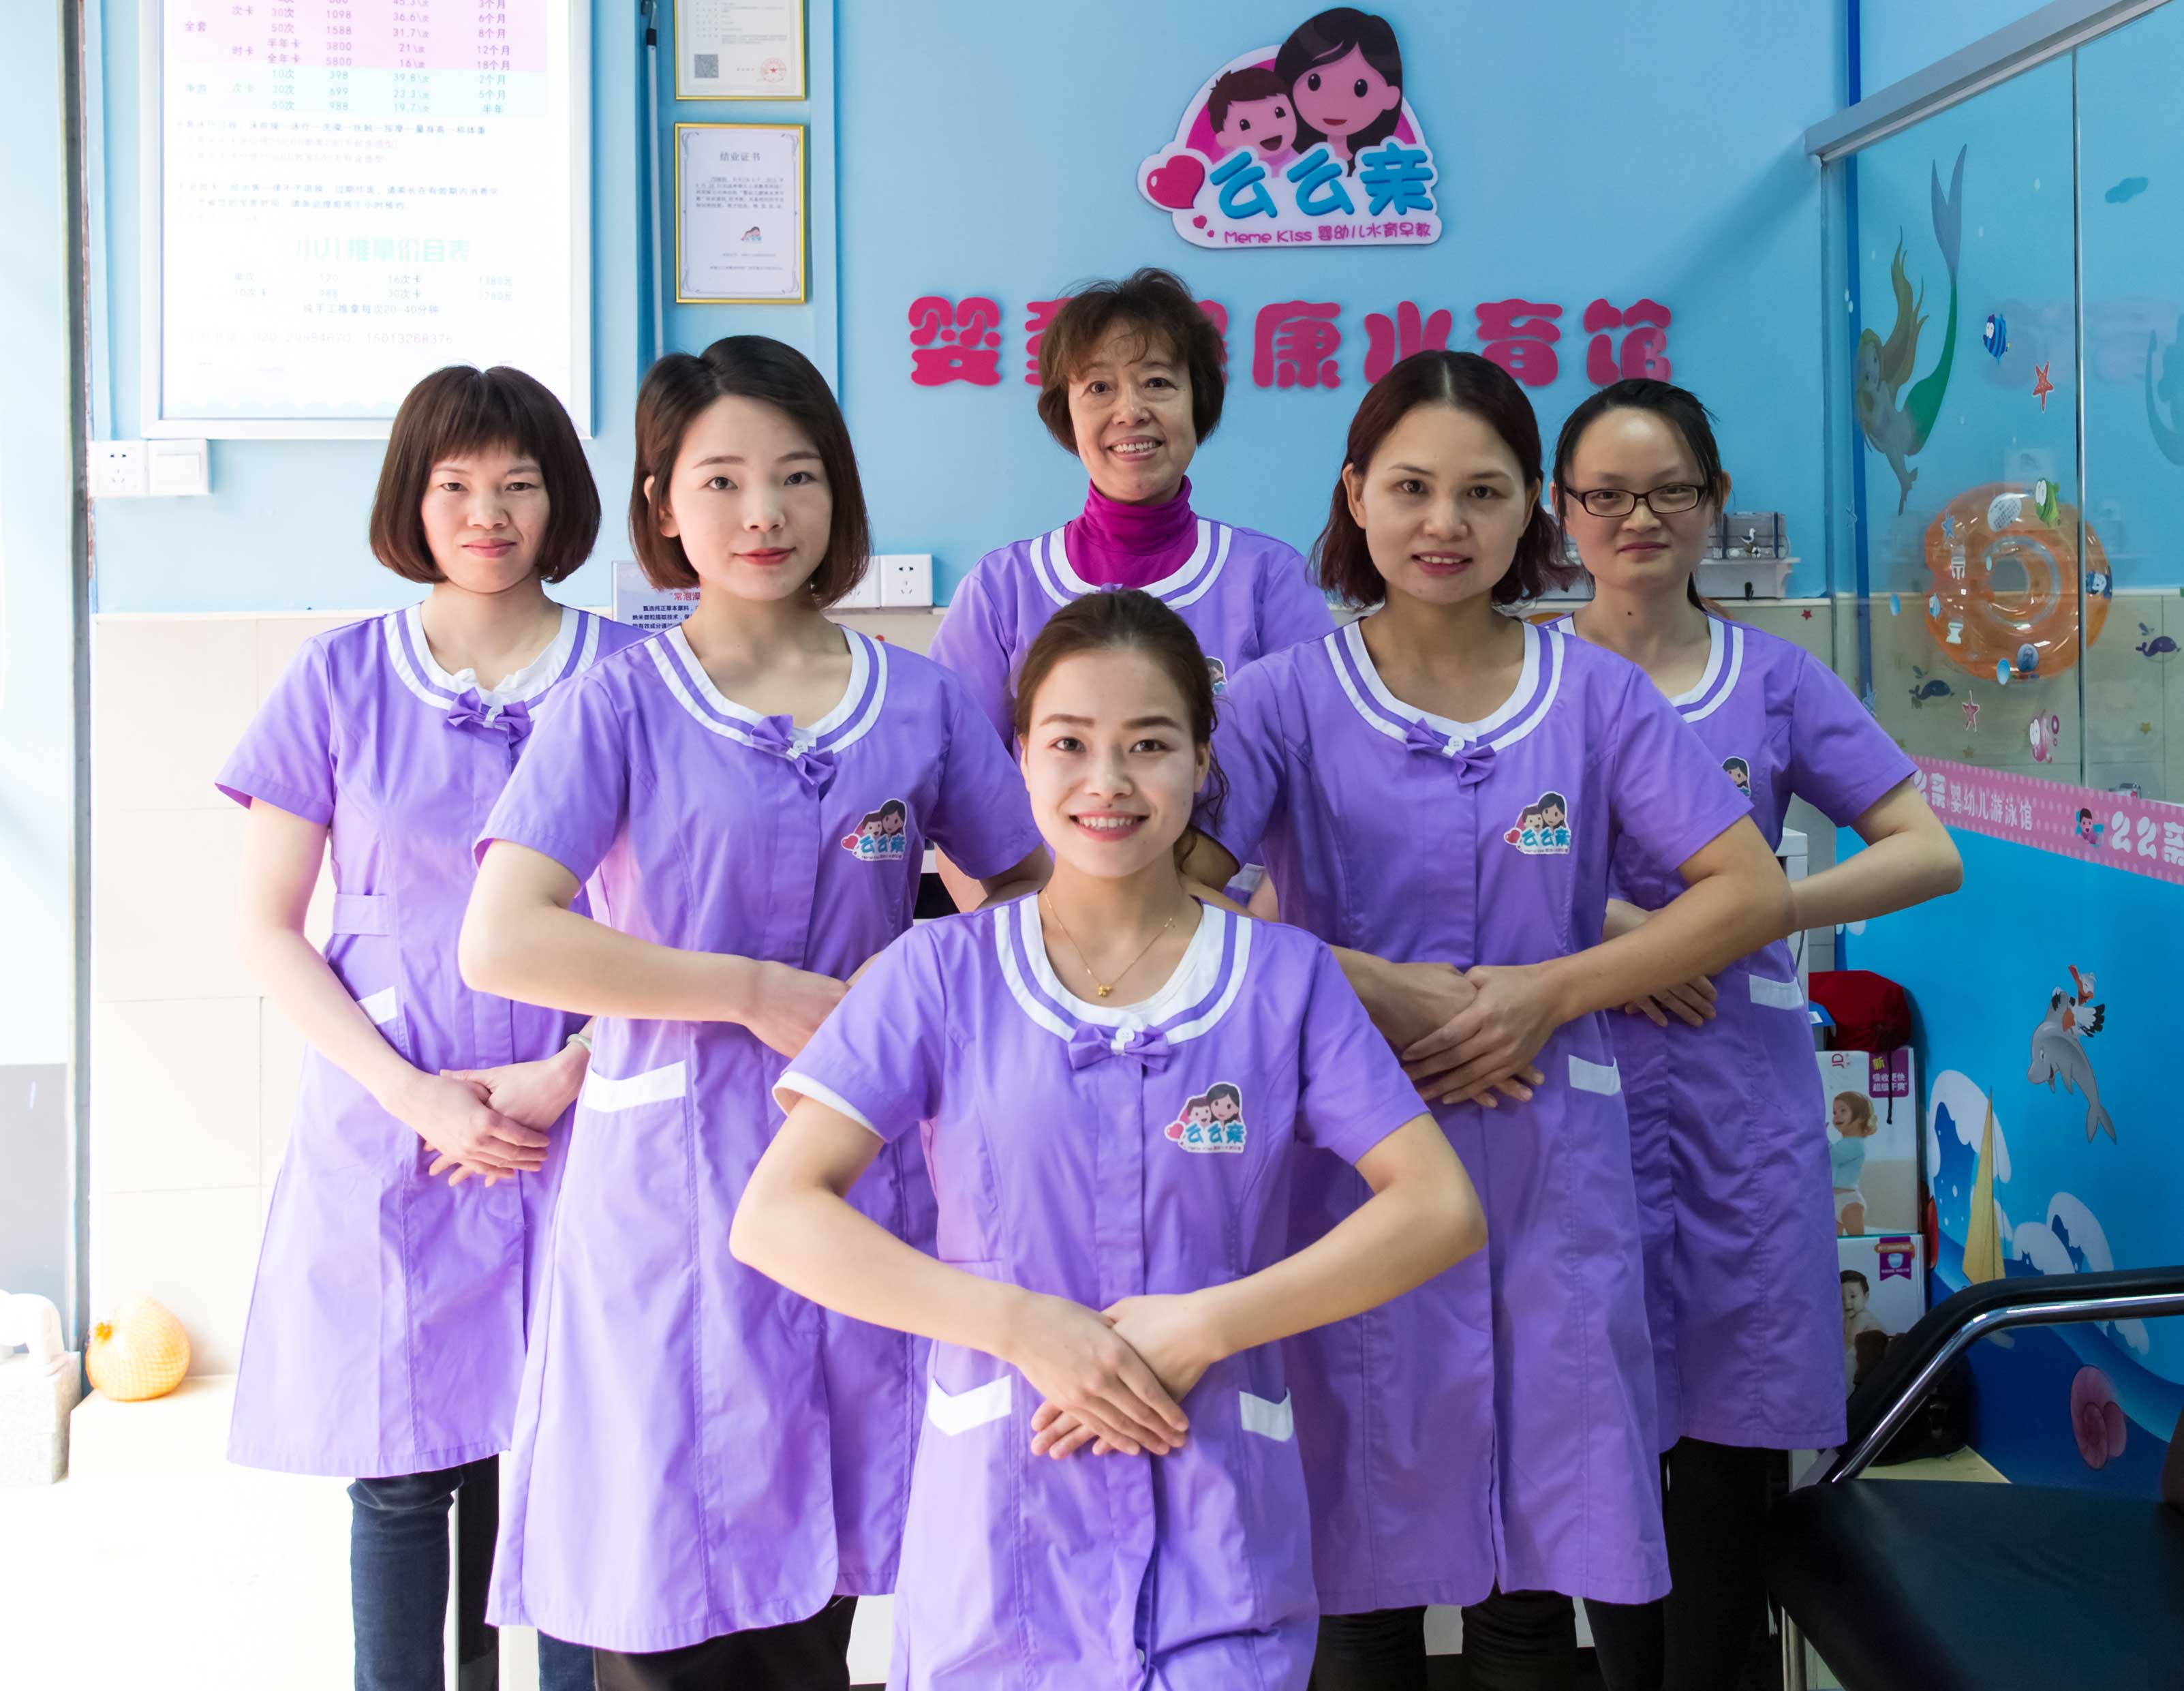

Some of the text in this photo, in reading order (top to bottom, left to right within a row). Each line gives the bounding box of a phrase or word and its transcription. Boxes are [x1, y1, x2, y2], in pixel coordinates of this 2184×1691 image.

[326, 10, 352, 20] 1098
[478, 14, 506, 25] 6个月
[326, 25, 352, 35] 1588
[478, 28, 506, 39] 8个月
[326, 42, 352, 52] 3800
[477, 45, 510, 56] 12个月
[326, 57, 352, 67] 5800
[477, 60, 510, 71] 18个月
[1210, 142, 1434, 219] 么么亲
[1224, 222, 1432, 245] Meme Kiss 婴幼儿水育早教
[1950, 777, 2033, 831] 婴幼儿游泳馆
